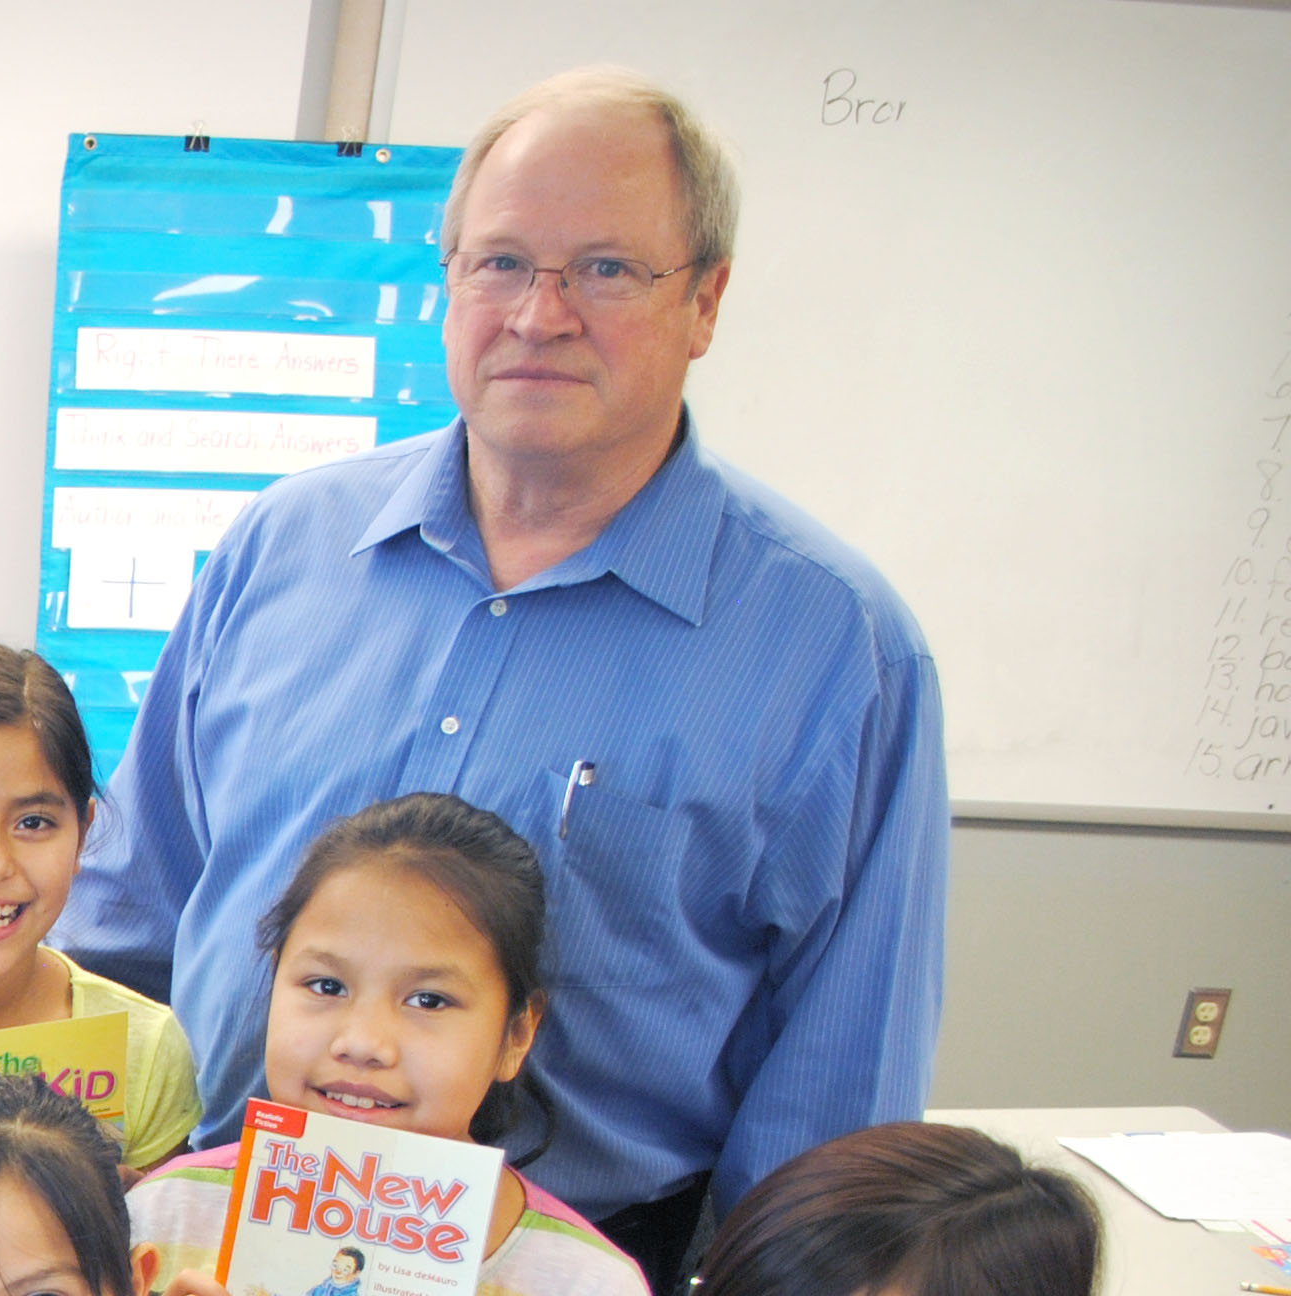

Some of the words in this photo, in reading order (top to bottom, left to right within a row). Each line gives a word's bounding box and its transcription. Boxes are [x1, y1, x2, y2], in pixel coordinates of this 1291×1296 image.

[274, 341, 360, 376] Answers
[266, 1139, 321, 1177] The
[318, 1145, 470, 1220] New
[249, 1167, 471, 1265] House
[378, 1262, 391, 1273] by
[393, 1265, 412, 1277] Lisa
